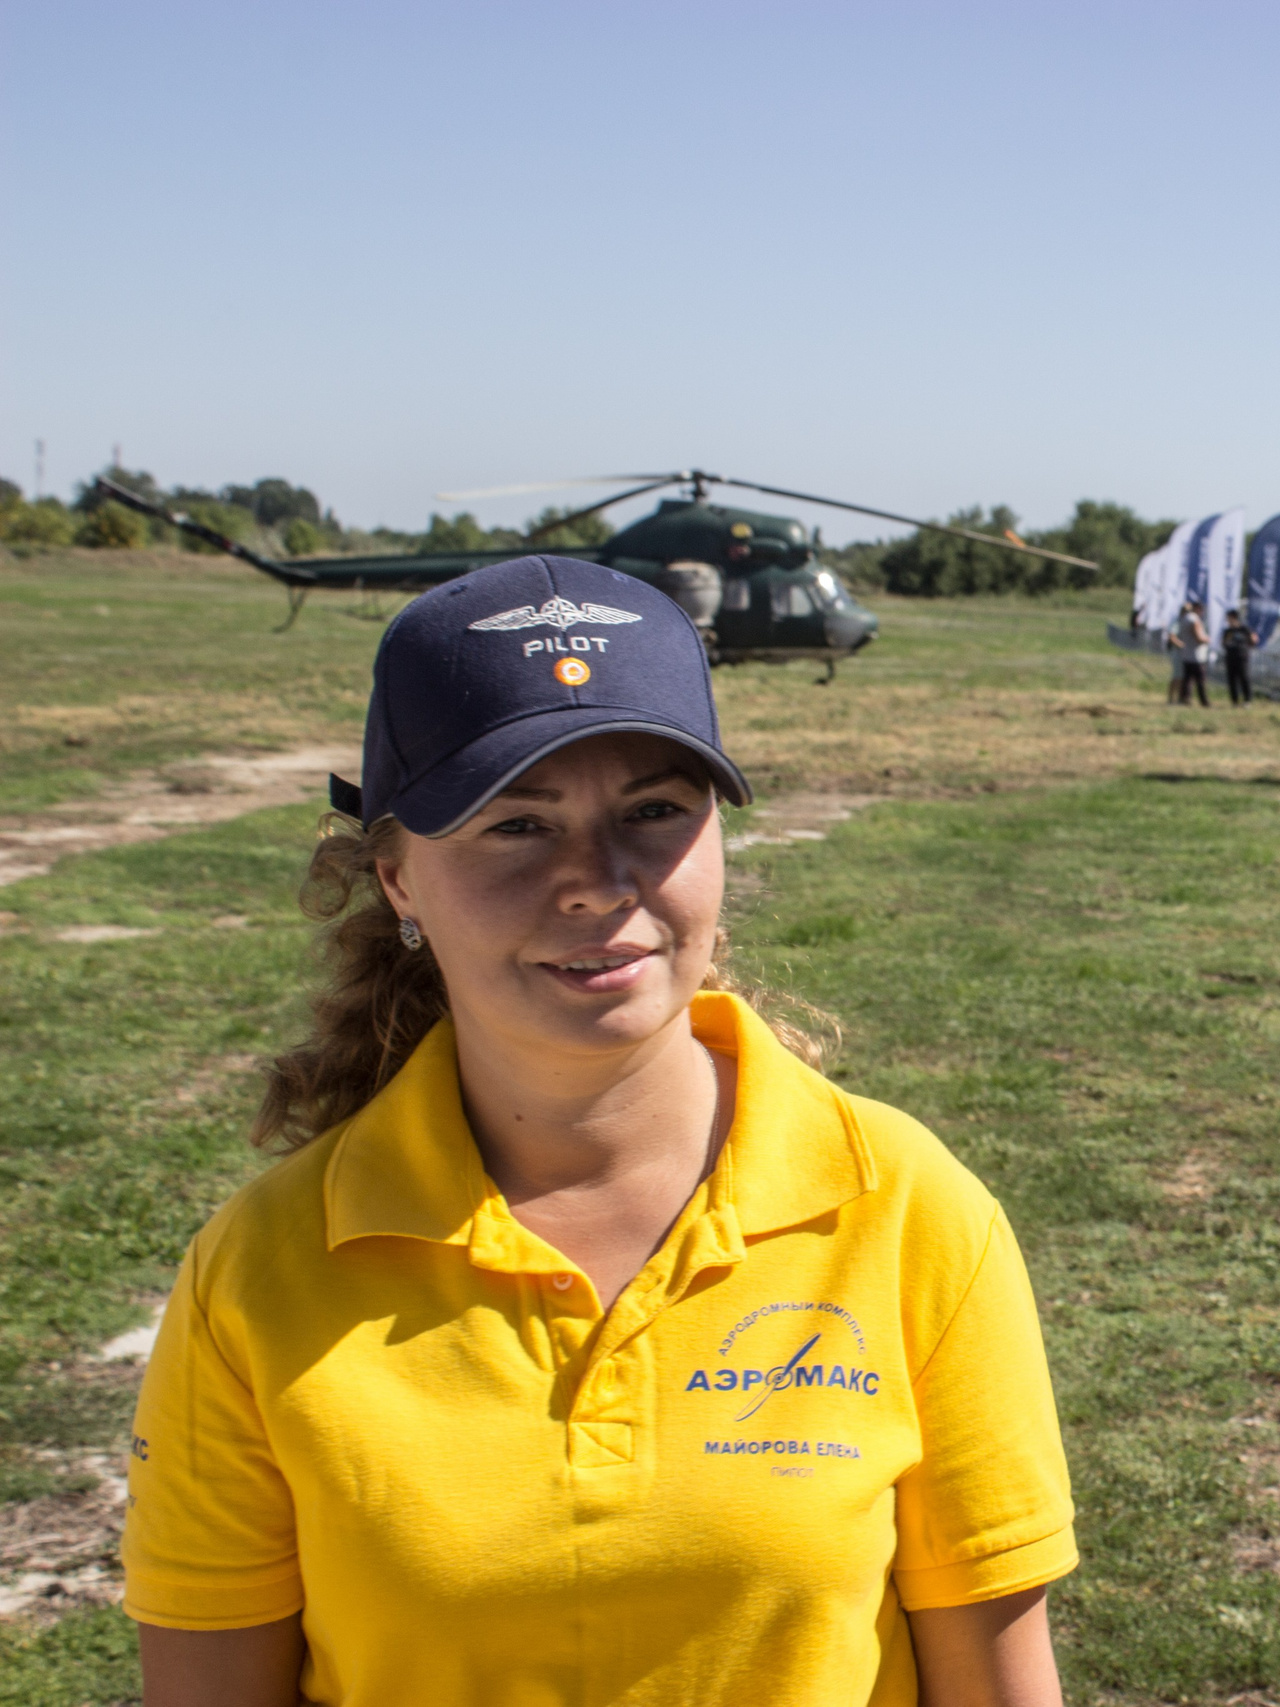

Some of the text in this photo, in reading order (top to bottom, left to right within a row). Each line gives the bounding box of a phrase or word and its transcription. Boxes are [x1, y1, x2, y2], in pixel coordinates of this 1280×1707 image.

[522, 636, 610, 658] PILOT
[685, 1364, 880, 1396] АЭРОМАКС
[704, 1438, 862, 1460] МАЙОРОВА ЕЛЕНА
